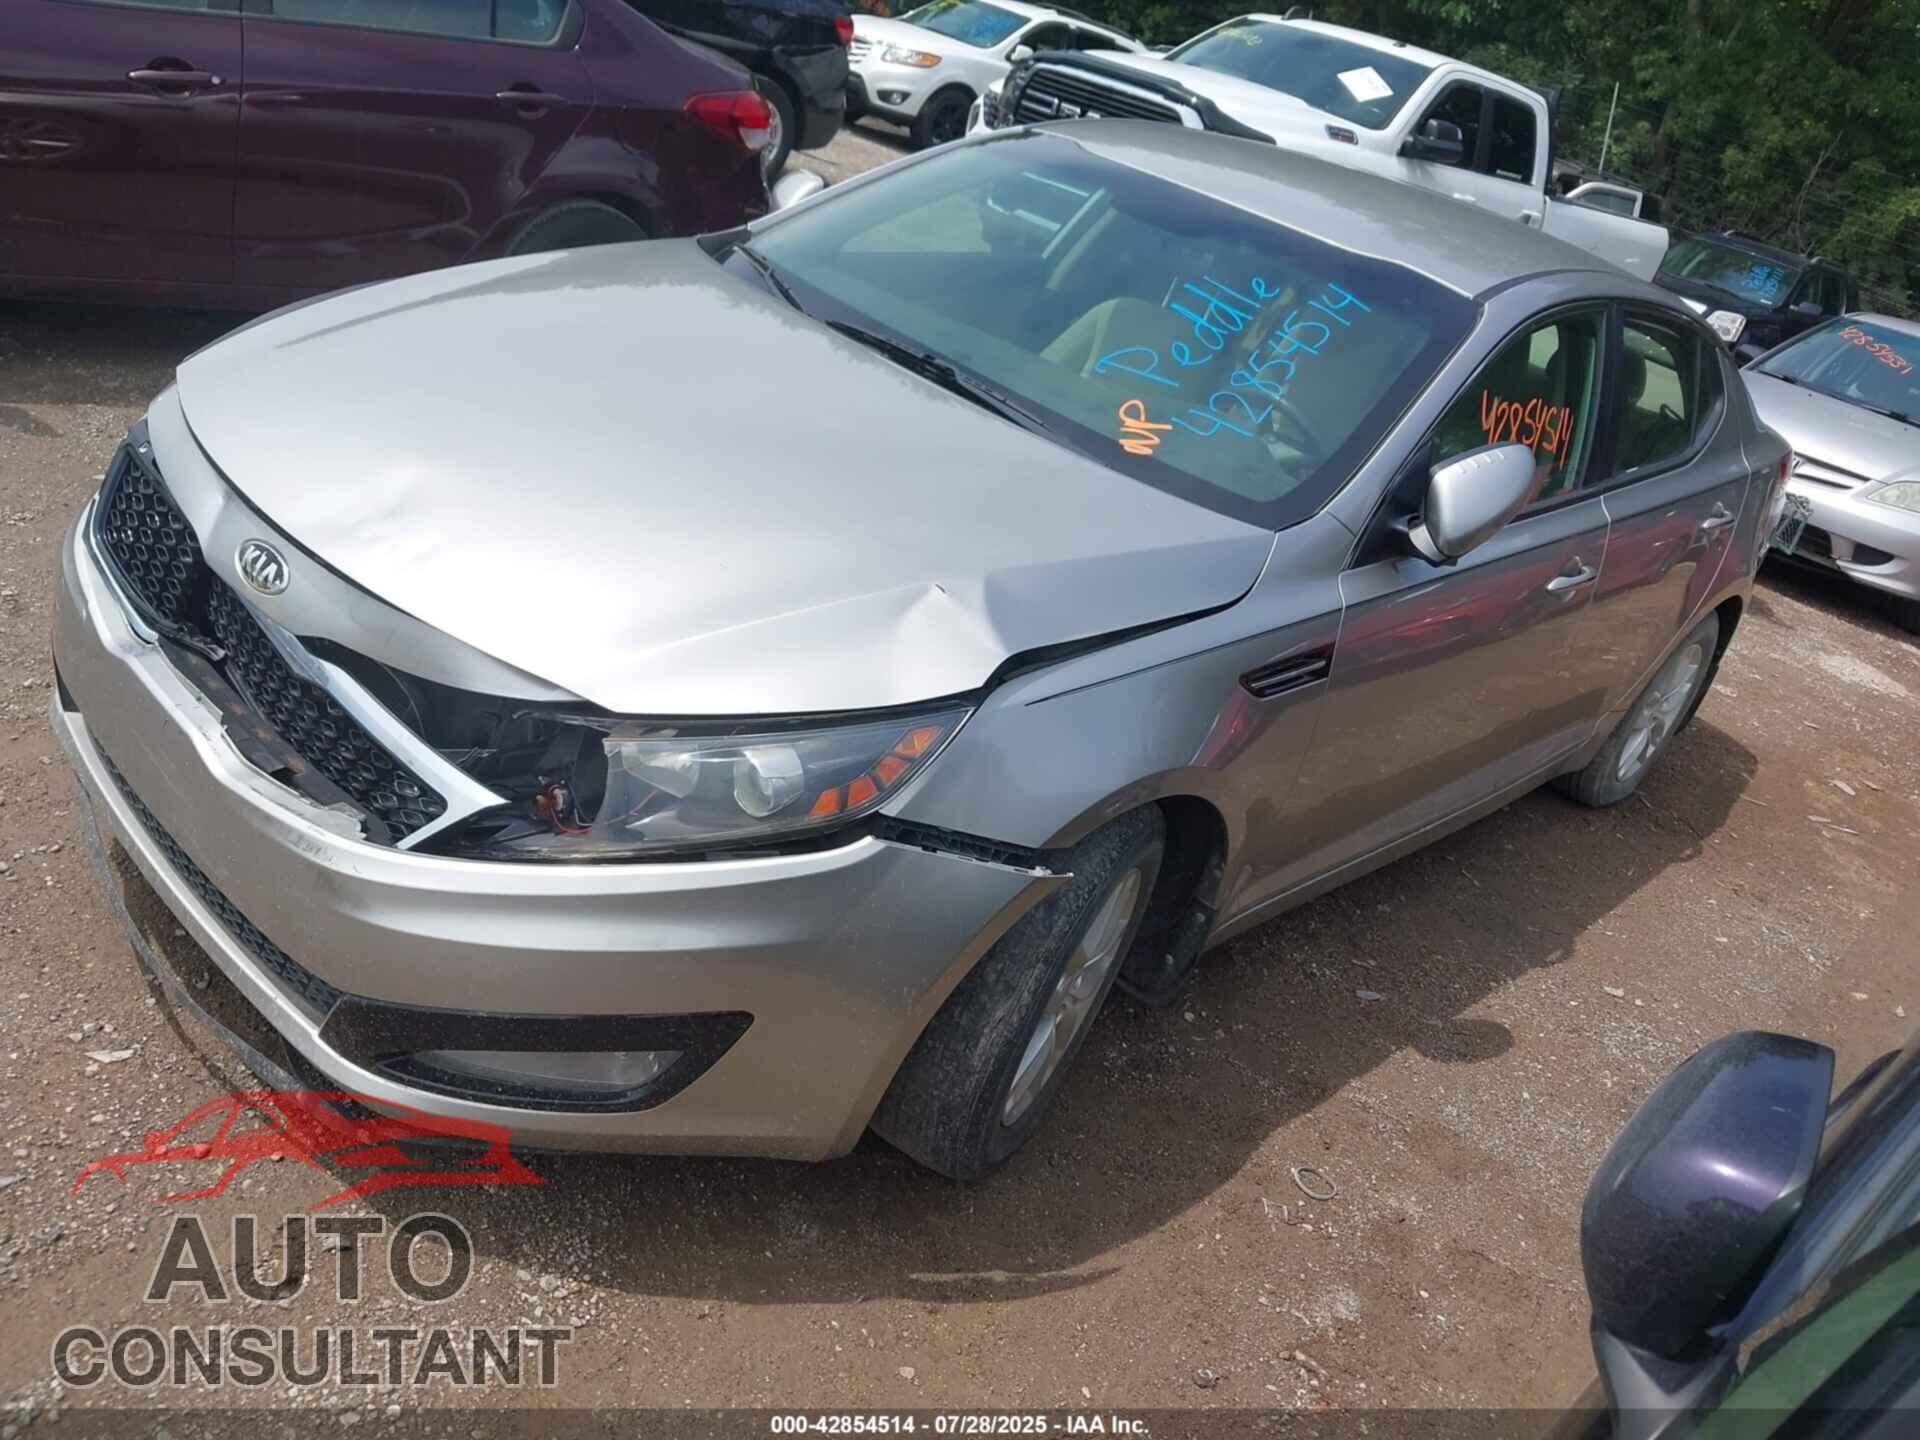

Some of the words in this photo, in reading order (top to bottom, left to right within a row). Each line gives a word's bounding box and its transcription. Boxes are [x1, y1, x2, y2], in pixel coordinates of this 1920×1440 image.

[1095, 275, 1280, 387] Peddle
[1170, 283, 1371, 437] 42854514
[240, 545, 281, 588] KIA
